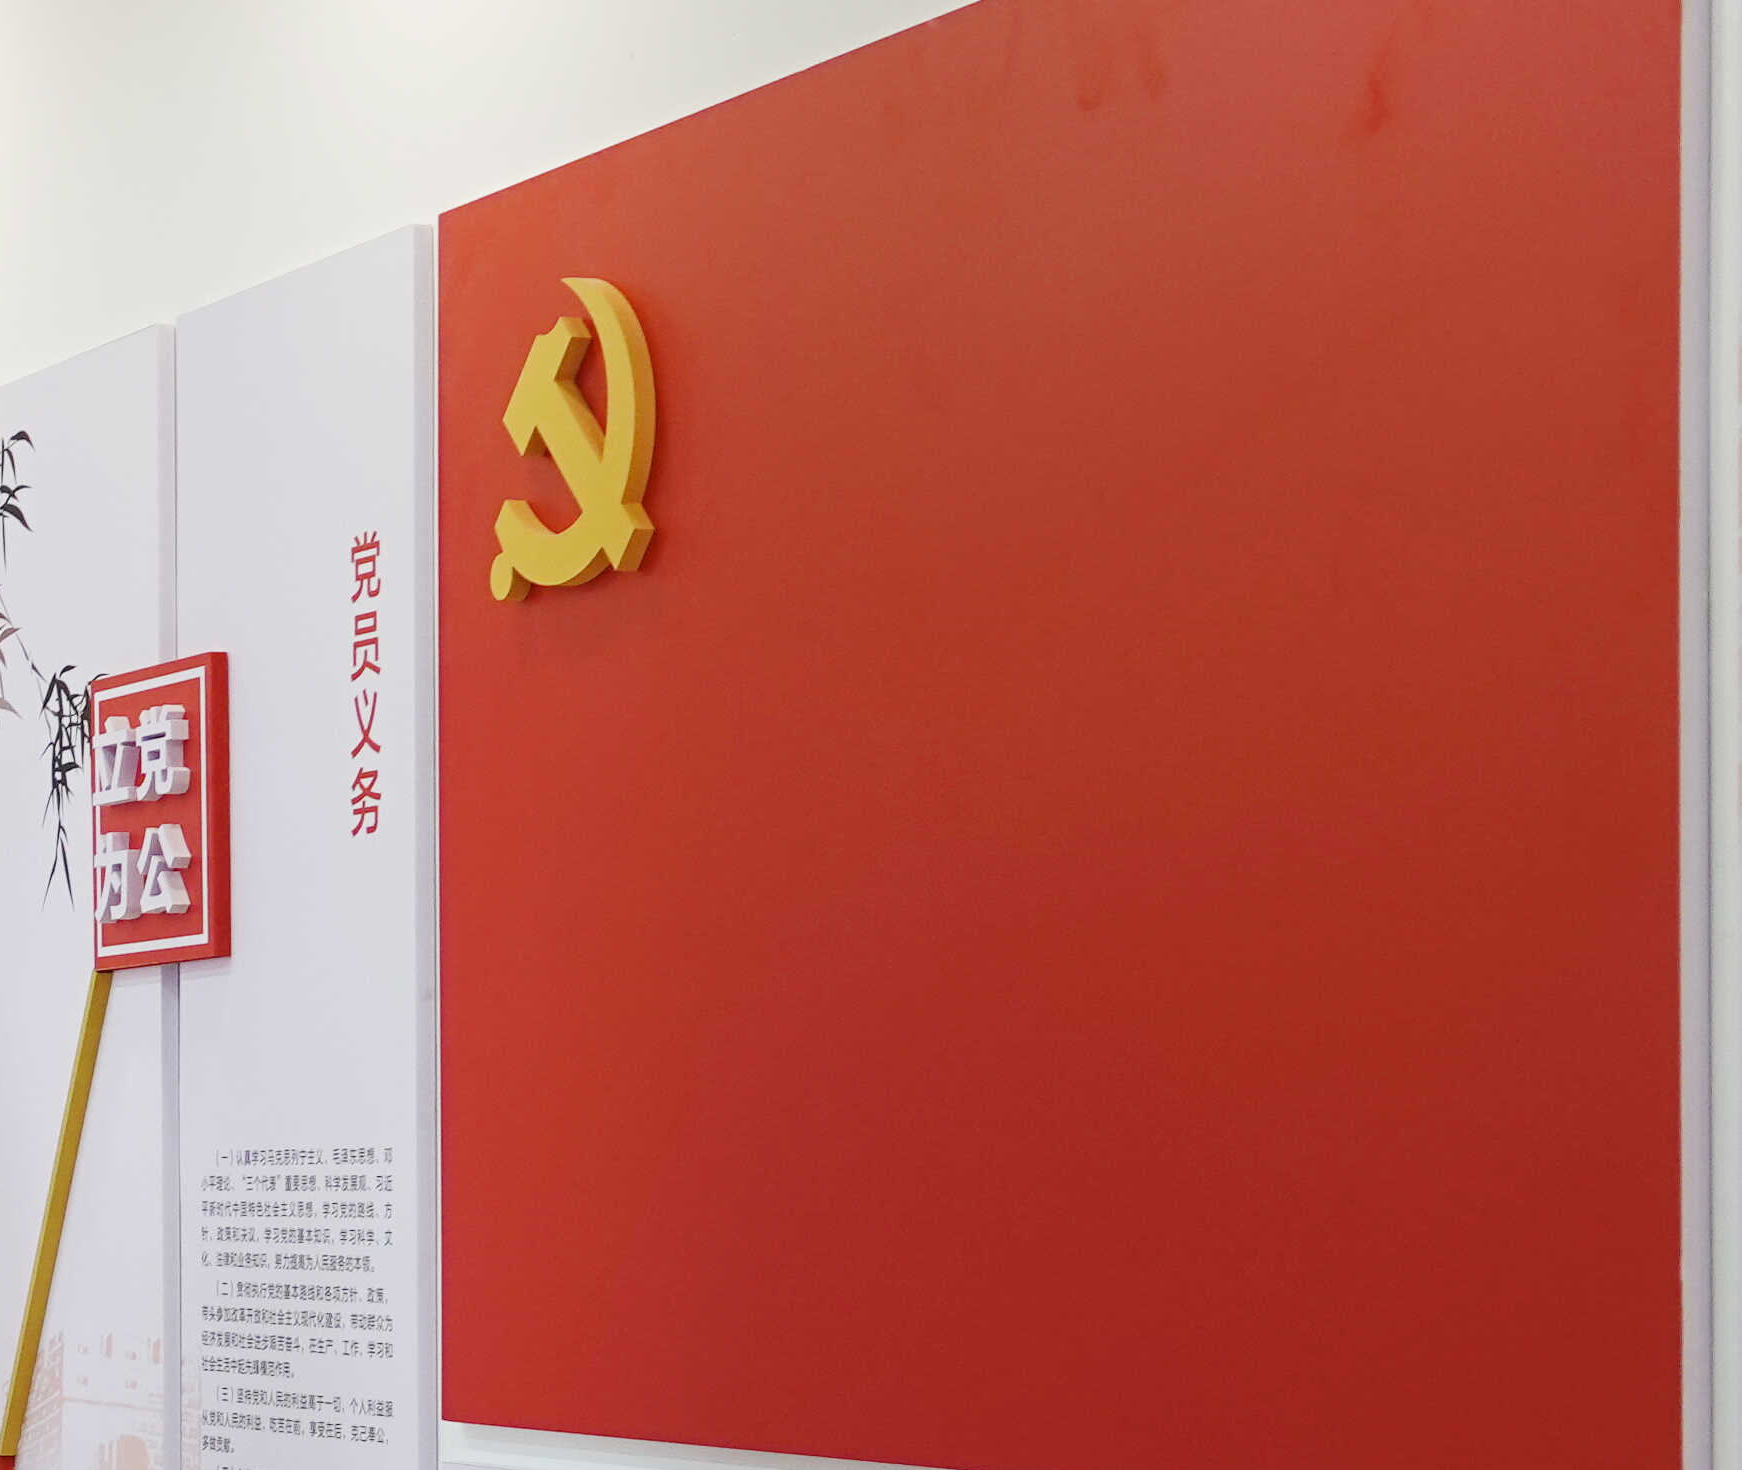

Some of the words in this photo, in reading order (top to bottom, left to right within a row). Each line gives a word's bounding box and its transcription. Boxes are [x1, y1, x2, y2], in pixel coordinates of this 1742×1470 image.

[350, 530, 382, 837] 党员义务
[93, 703, 192, 807] 立党
[93, 823, 193, 923] 为公
